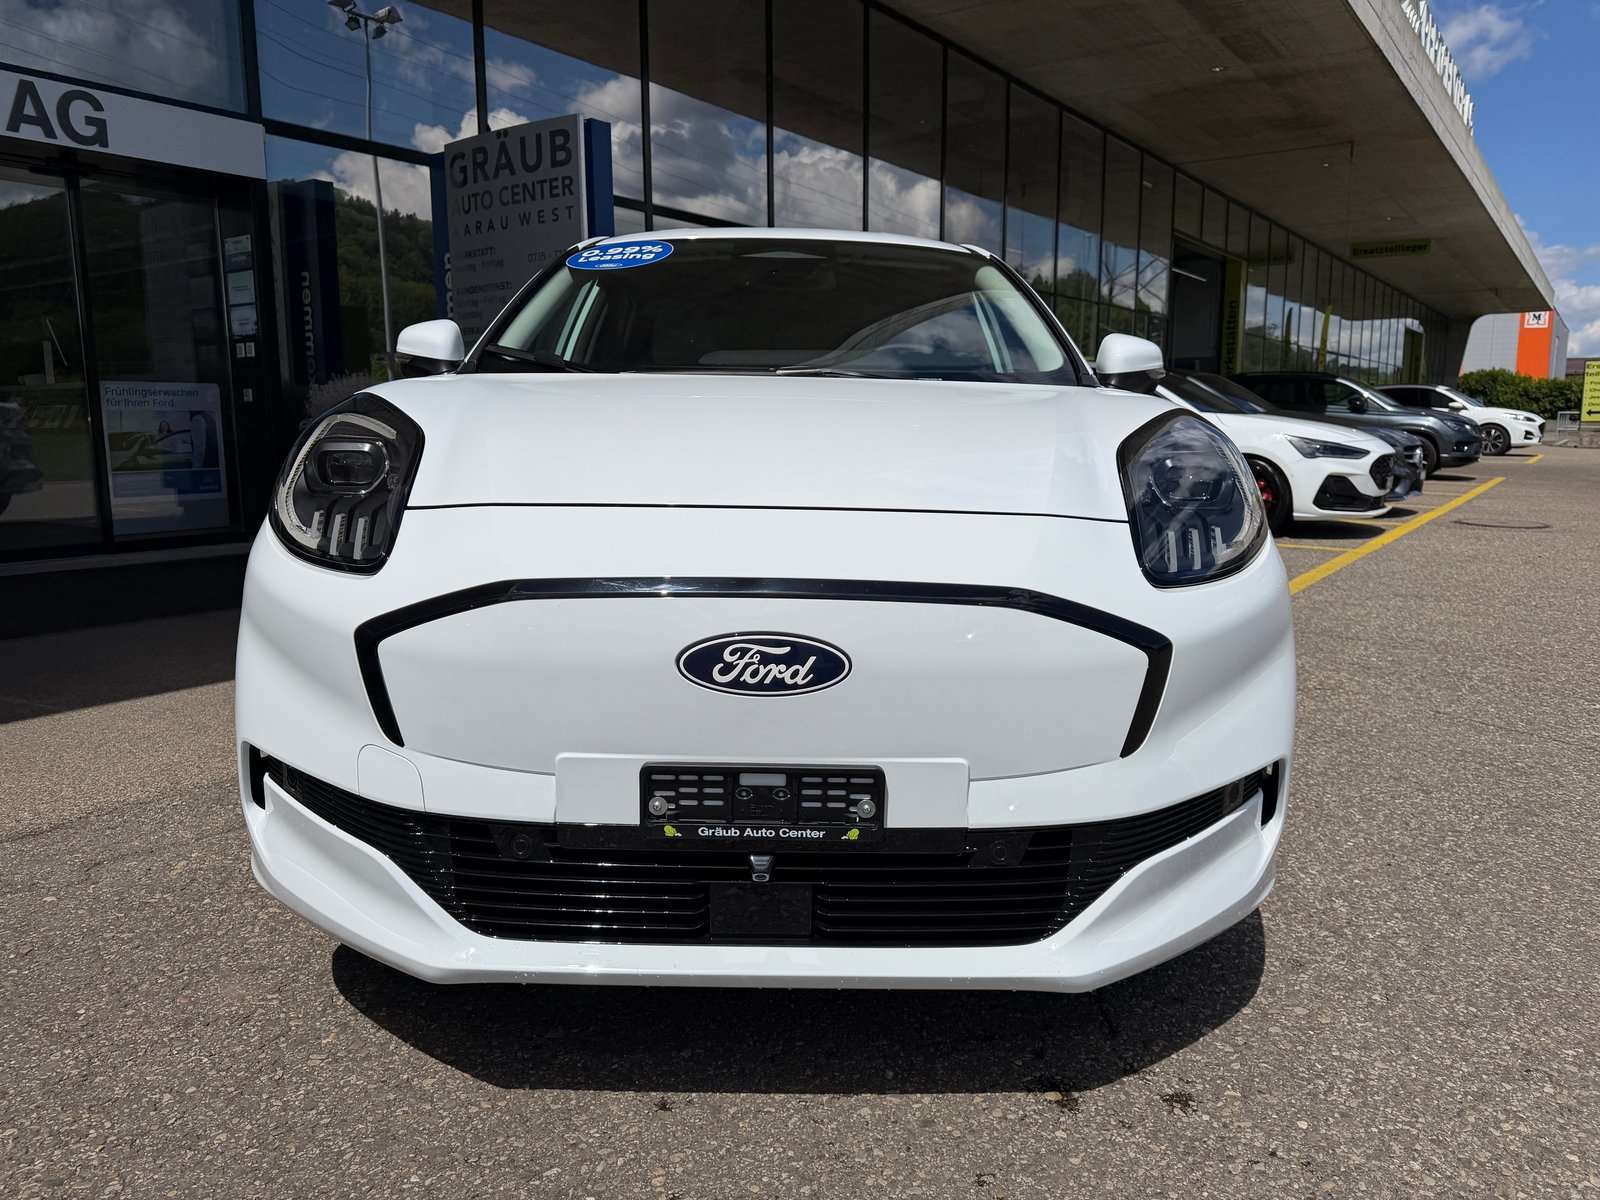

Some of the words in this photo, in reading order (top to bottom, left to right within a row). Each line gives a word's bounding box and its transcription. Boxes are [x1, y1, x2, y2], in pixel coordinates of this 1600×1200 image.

[6, 78, 109, 148] AG
[449, 129, 573, 188] GRÄUB
[499, 175, 574, 206] CENTER
[518, 205, 574, 227] WEST
[578, 252, 656, 263] Leasing
[581, 245, 663, 257] 0.99%
[104, 386, 199, 398] Frühlingserwachen
[105, 398, 121, 408] für
[124, 398, 150, 407] Ihren
[711, 643, 817, 685] Ford
[698, 826, 740, 838] Gräub
[743, 827, 776, 838] Auto
[778, 827, 826, 839] Center
